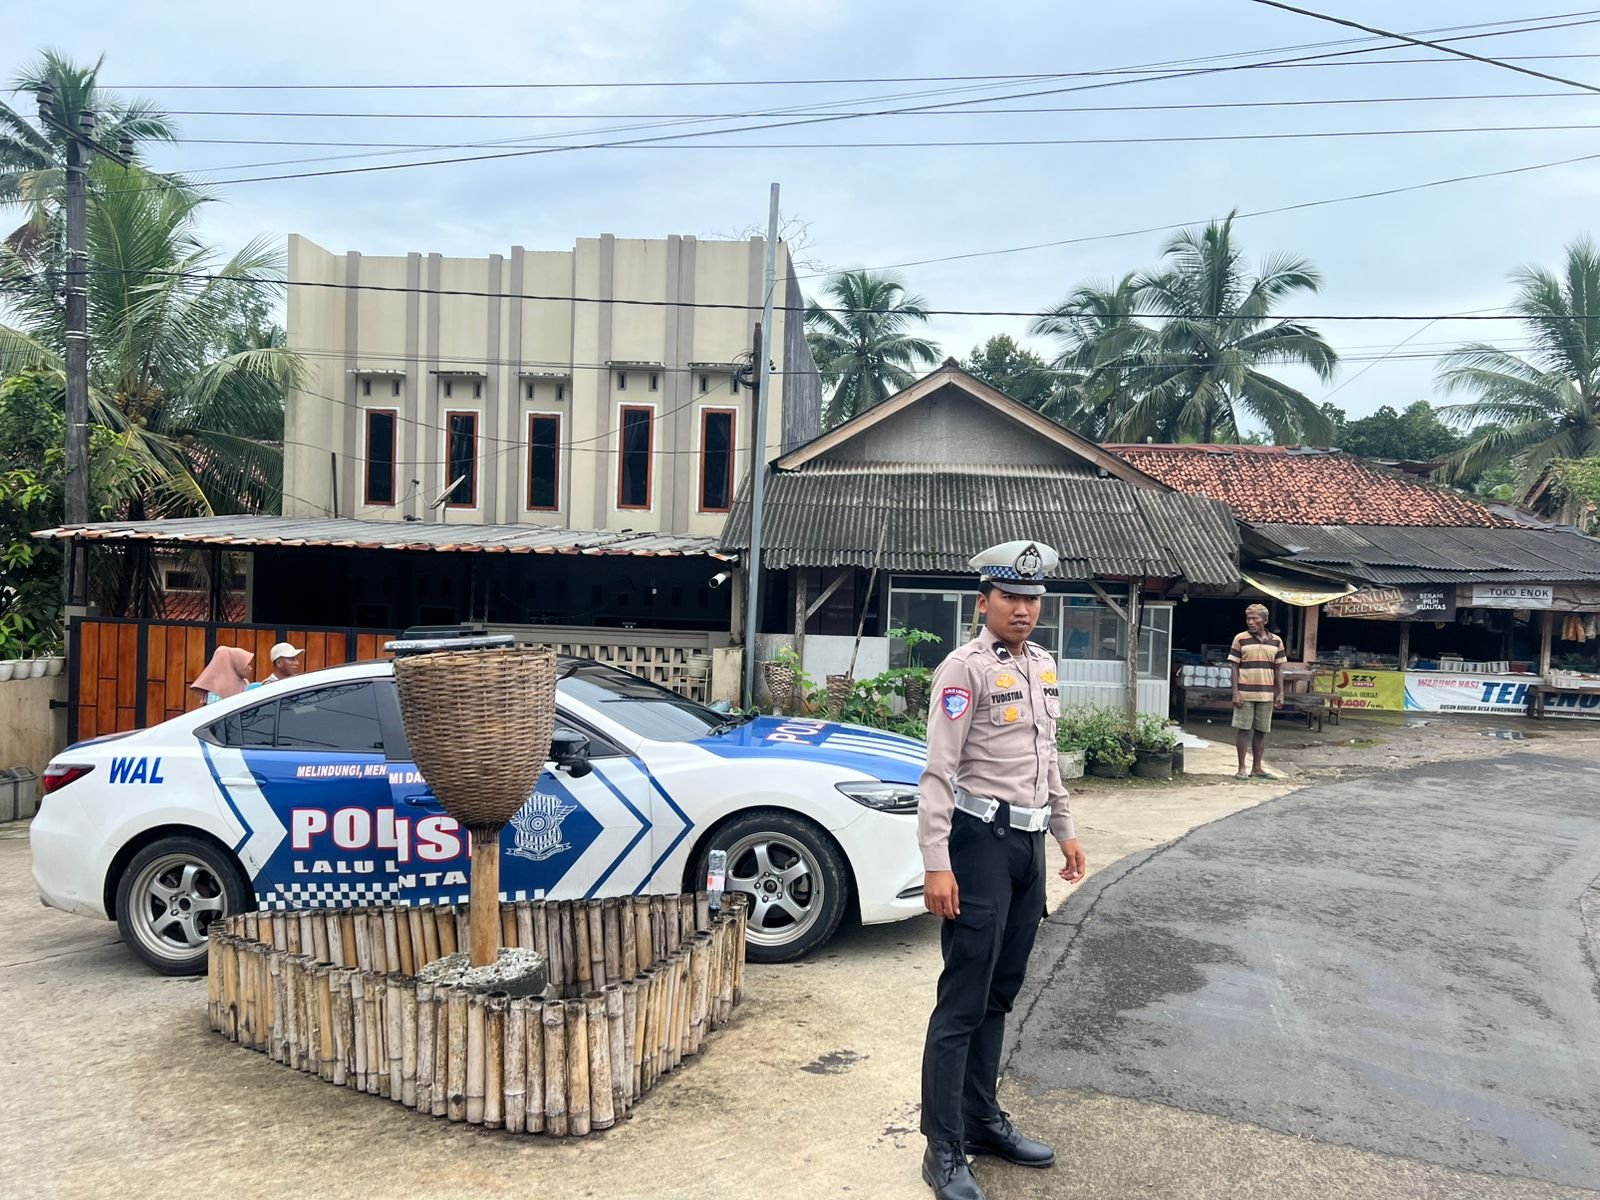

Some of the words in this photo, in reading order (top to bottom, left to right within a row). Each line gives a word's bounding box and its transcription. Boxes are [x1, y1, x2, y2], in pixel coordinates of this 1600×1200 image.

[1488, 588, 1517, 596] TOKO
[1520, 589, 1549, 597] ENOK
[1416, 603, 1447, 611] KUALITAS
[1417, 678, 1457, 688] WARUNG
[1458, 680, 1480, 689] NASI
[991, 690, 1024, 704] YUDISTIRA
[109, 756, 164, 784] WAL
[296, 765, 363, 778] MELINDUNGI,
[405, 772, 427, 784] DA
[293, 860, 375, 874] LALU
